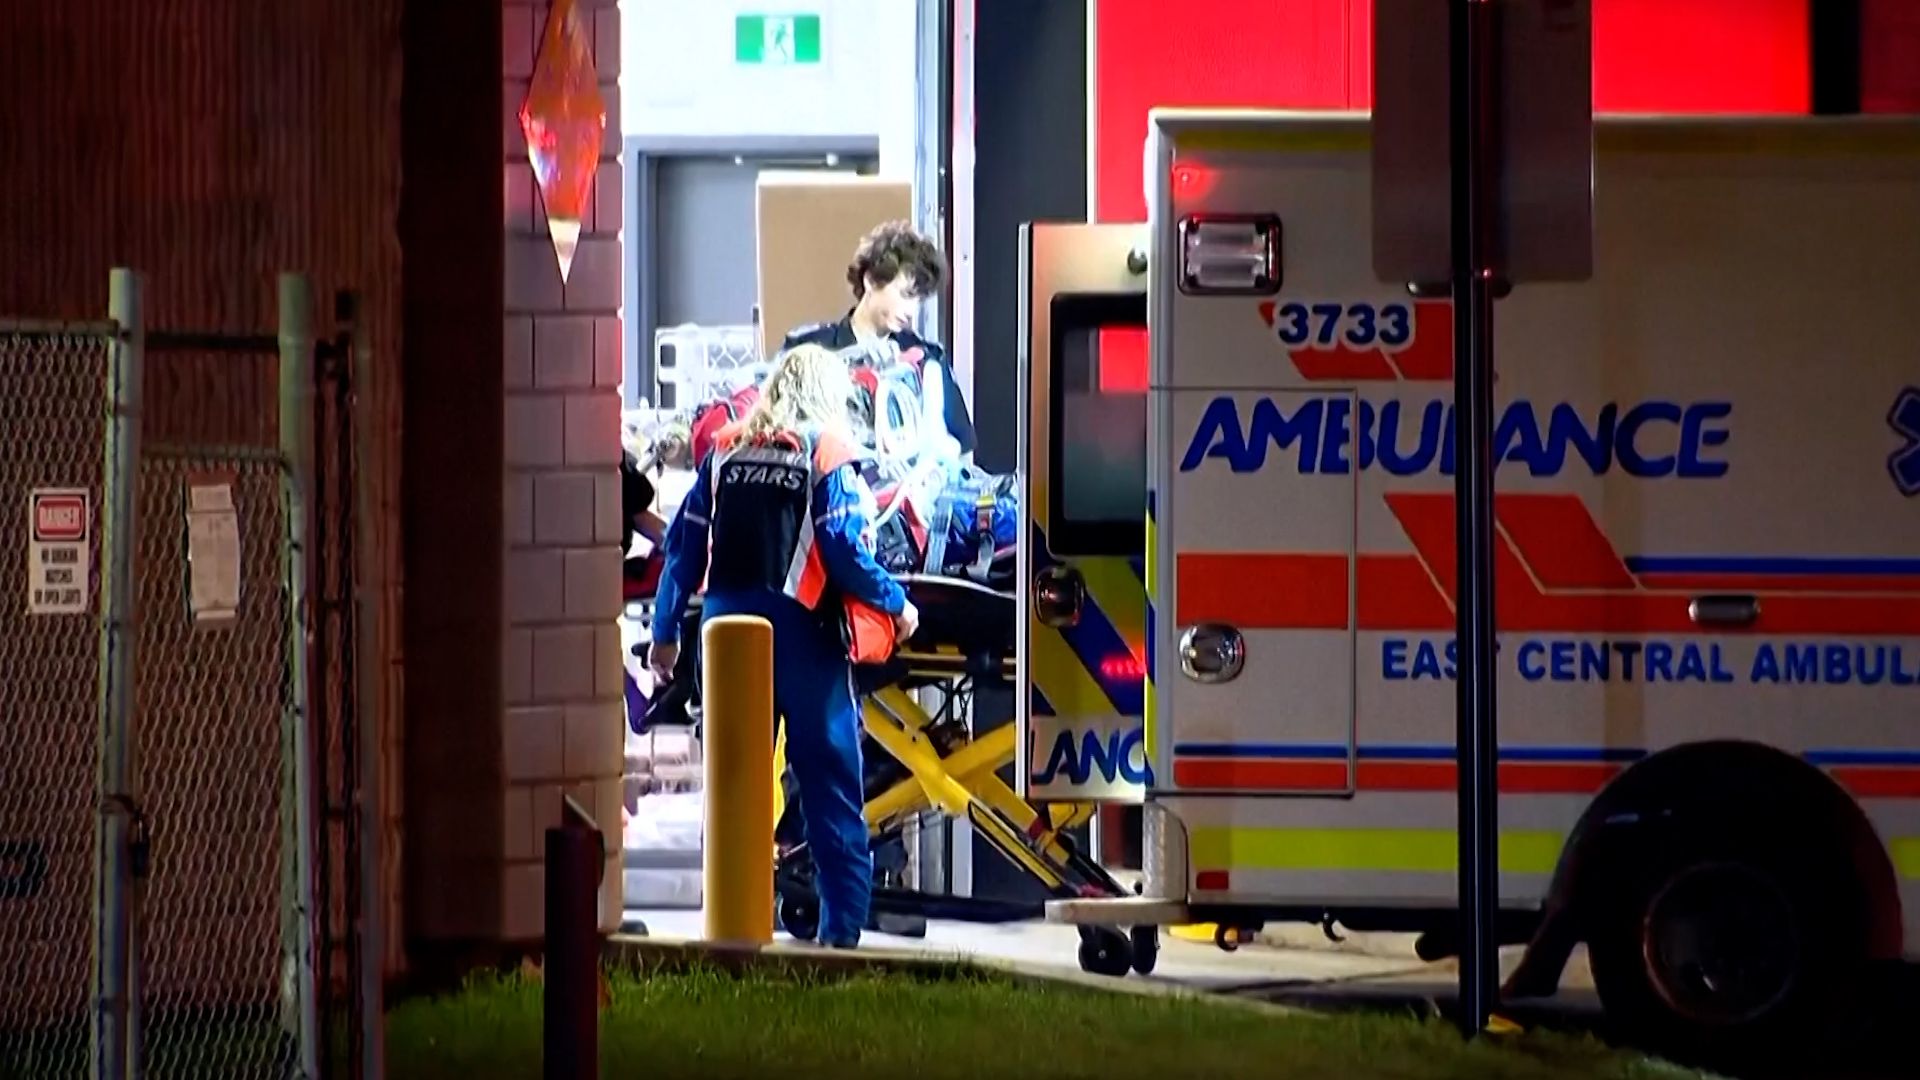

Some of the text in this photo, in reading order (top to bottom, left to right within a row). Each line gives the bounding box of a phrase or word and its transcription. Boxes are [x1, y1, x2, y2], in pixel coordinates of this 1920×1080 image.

[1278, 304, 1410, 345] 3733
[726, 465, 804, 490] STARS
[1517, 640, 1734, 682] CENTRAL
[1751, 643, 1920, 685] AMBUL
